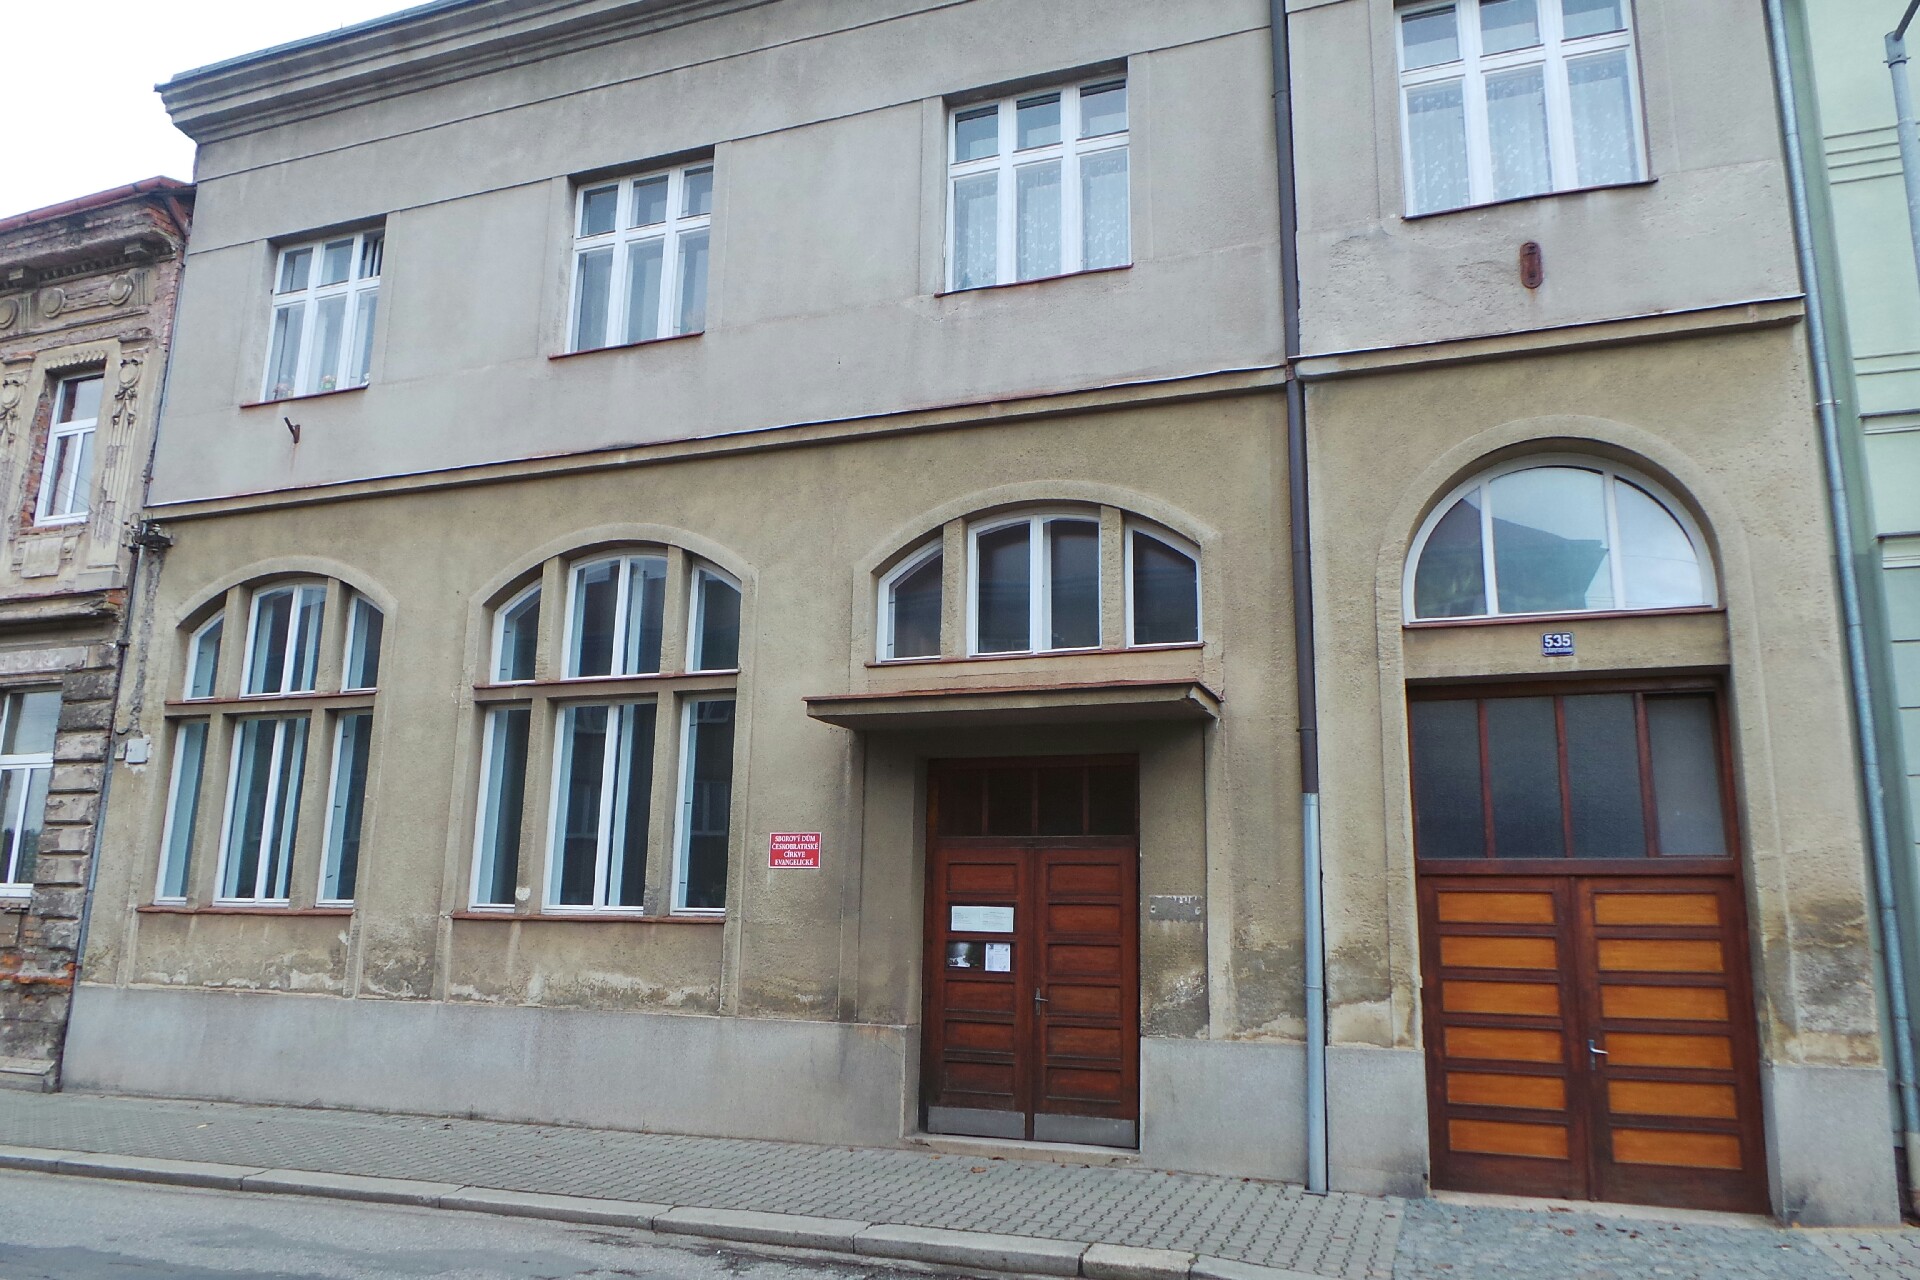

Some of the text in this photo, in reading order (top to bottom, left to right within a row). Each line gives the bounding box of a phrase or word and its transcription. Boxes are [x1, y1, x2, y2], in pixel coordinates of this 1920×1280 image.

[1544, 634, 1571, 647] 535
[774, 834, 816, 842] SBOROVÝ DŮM
[771, 842, 819, 850] ČESKOBRATRSKÉ
[783, 850, 806, 858] CÍRKVE
[774, 858, 814, 866] EVANGELICKÉ
